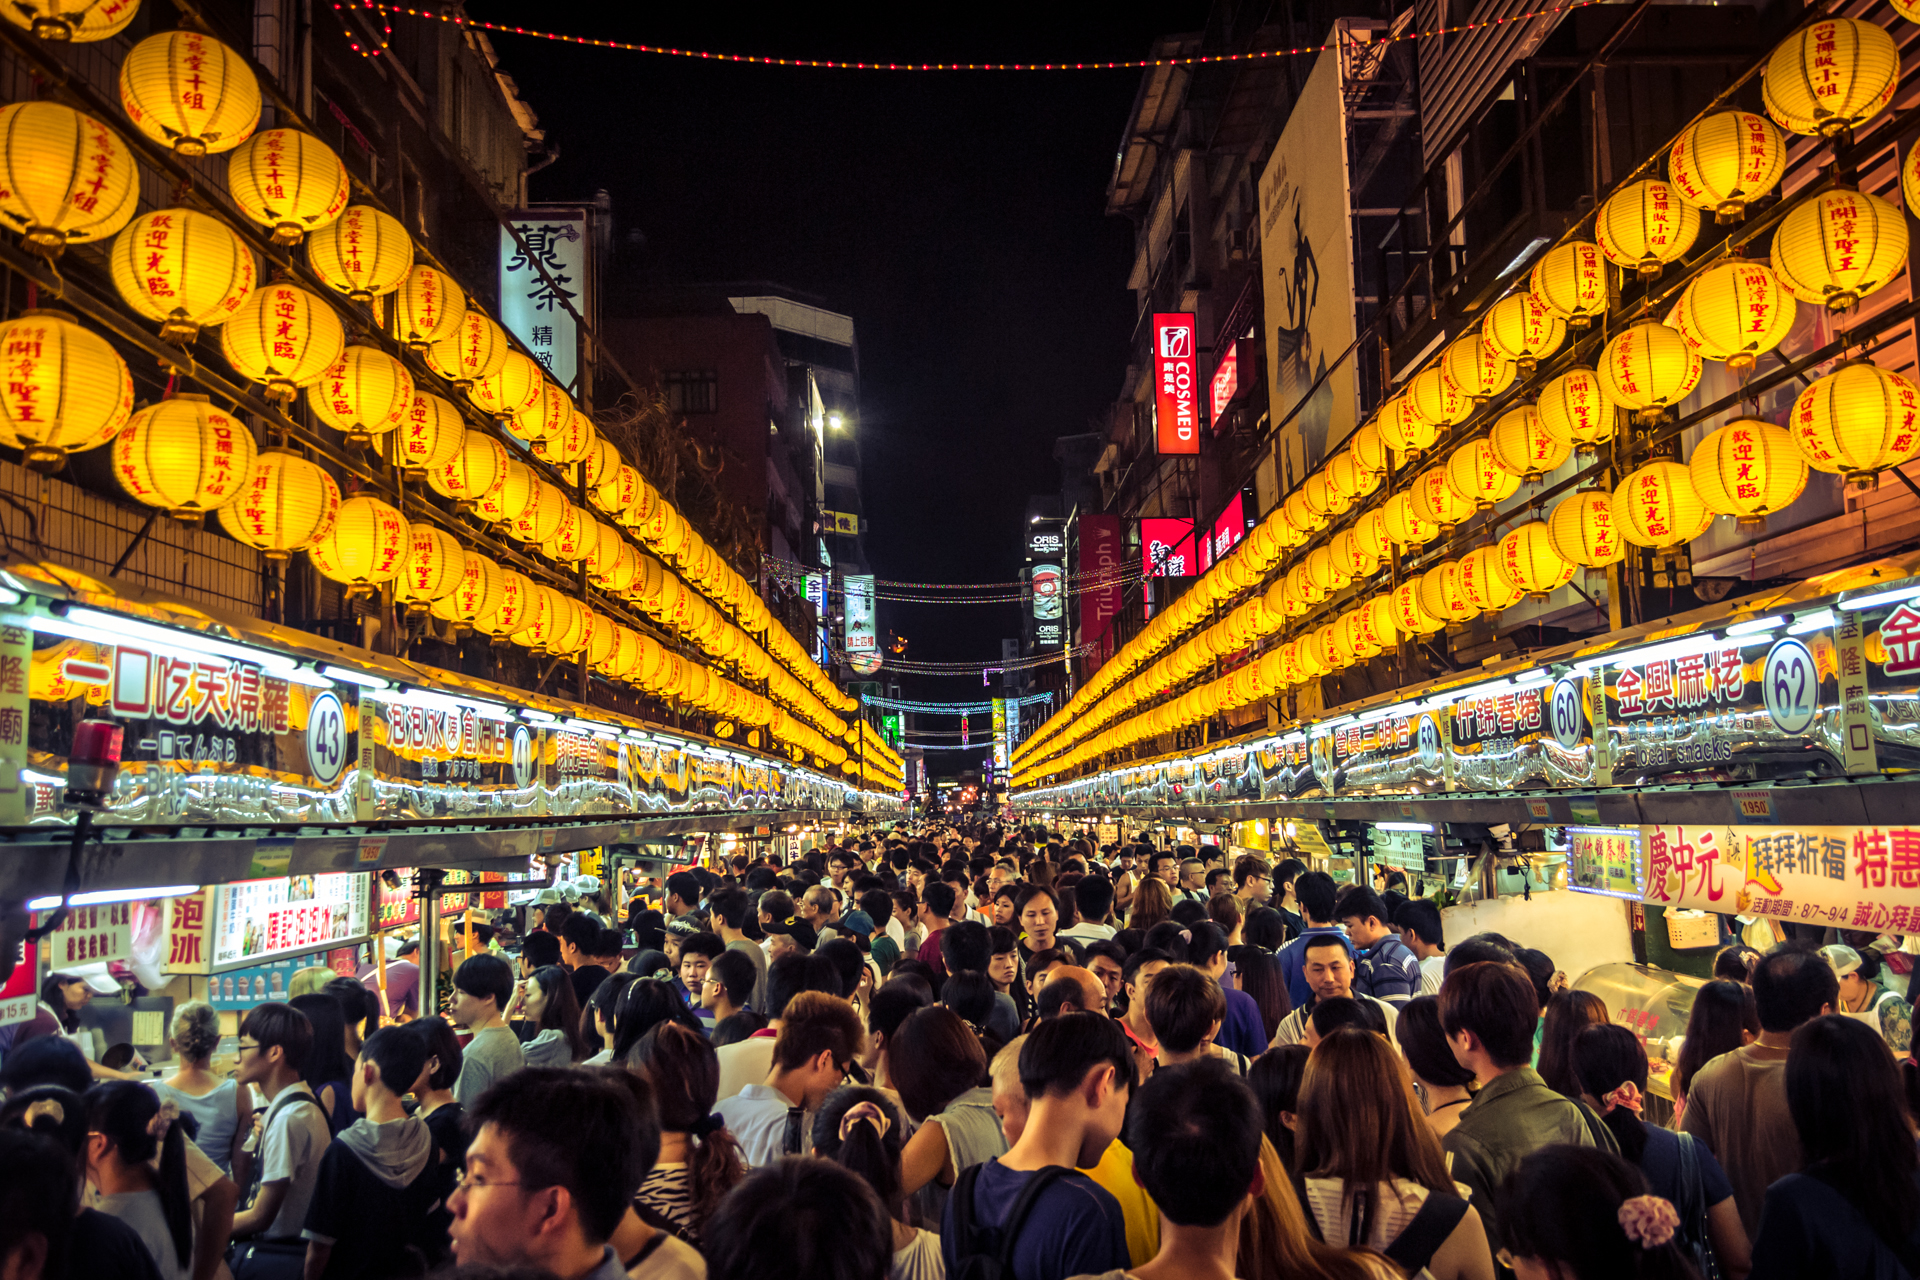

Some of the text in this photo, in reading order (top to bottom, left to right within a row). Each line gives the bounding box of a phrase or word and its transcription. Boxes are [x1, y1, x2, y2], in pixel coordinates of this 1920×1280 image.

[1163, 362, 1176, 394] 康是美
[1176, 361, 1192, 441] COSMED
[1033, 535, 1059, 544] ORIS
[1095, 543, 1113, 621] Triumph
[63, 643, 290, 735] 一口吃天婦羅
[1773, 656, 1809, 718] 62
[1557, 691, 1577, 737] 60
[140, 730, 237, 764] 一口てんぷら
[316, 710, 339, 766] 43
[517, 739, 528, 778] 41
[1421, 725, 1434, 755] 58
[1635, 736, 1733, 767] local snacks
[847, 793, 856, 804] 25
[1743, 800, 1767, 814] 1950
[361, 846, 382, 861] 1950
[1645, 824, 1724, 904] 慶中元
[1751, 833, 1847, 882] 拜拜祈福
[1852, 827, 1920, 890] 特惠
